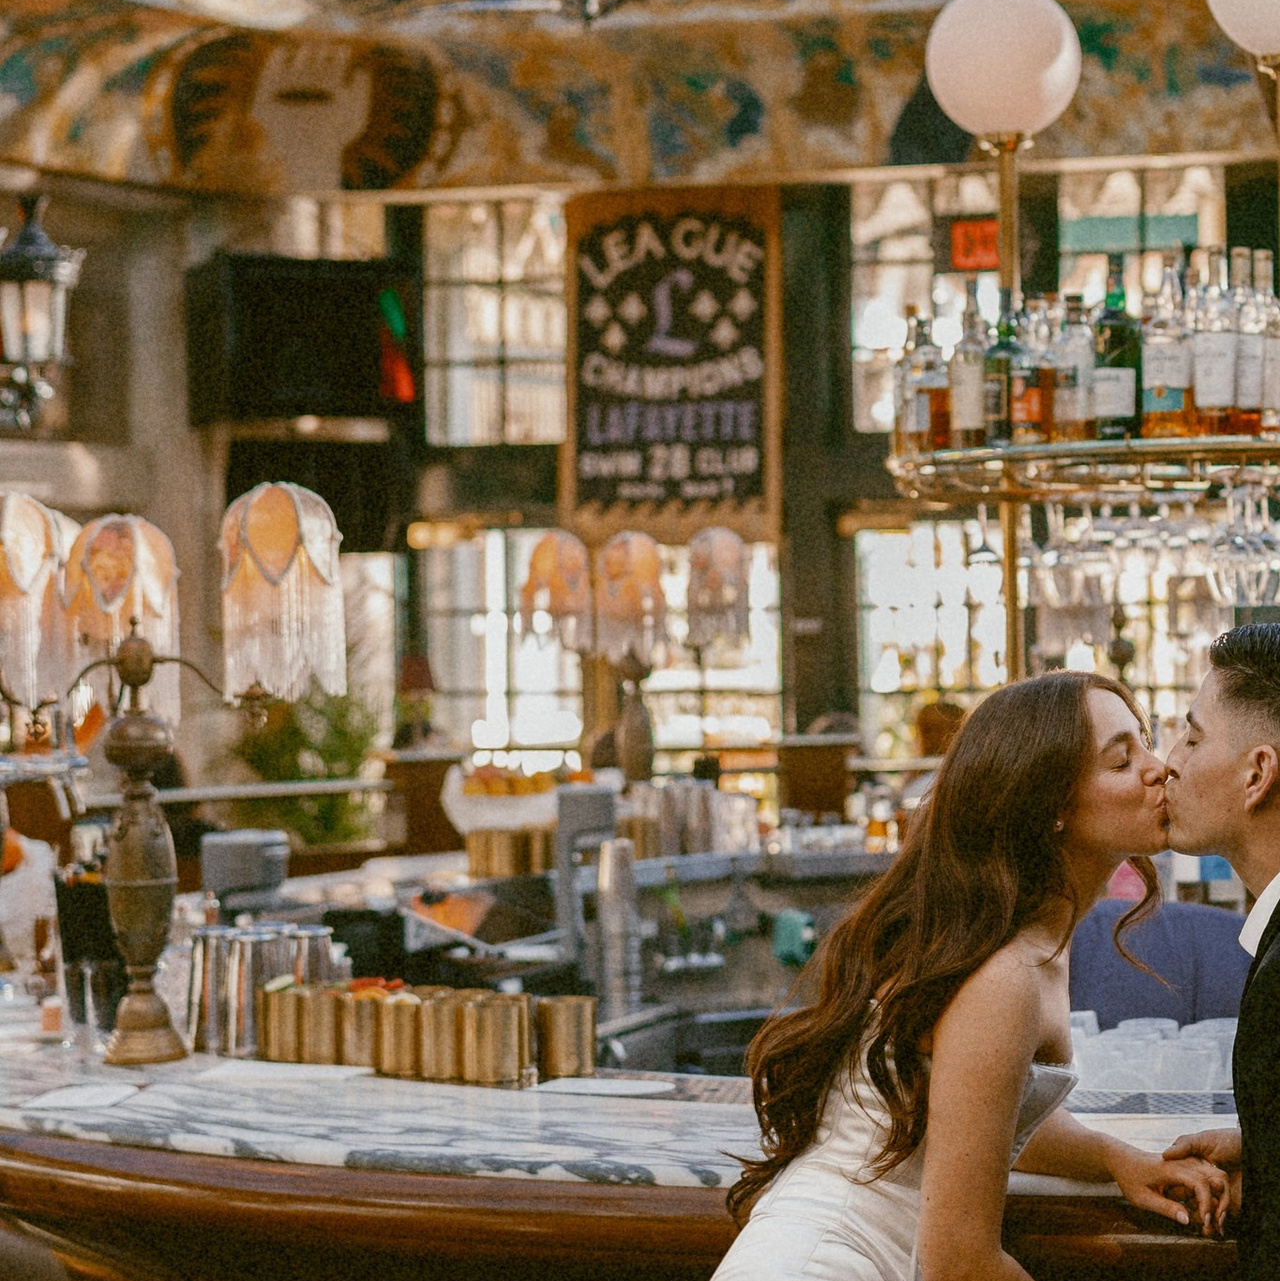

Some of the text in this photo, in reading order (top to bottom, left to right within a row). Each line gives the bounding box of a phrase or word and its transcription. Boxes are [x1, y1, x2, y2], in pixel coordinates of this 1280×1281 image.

[579, 217, 765, 285] LEAGUE
[581, 346, 764, 400] CHAMPIONS
[586, 401, 757, 445] LAFAYETTE
